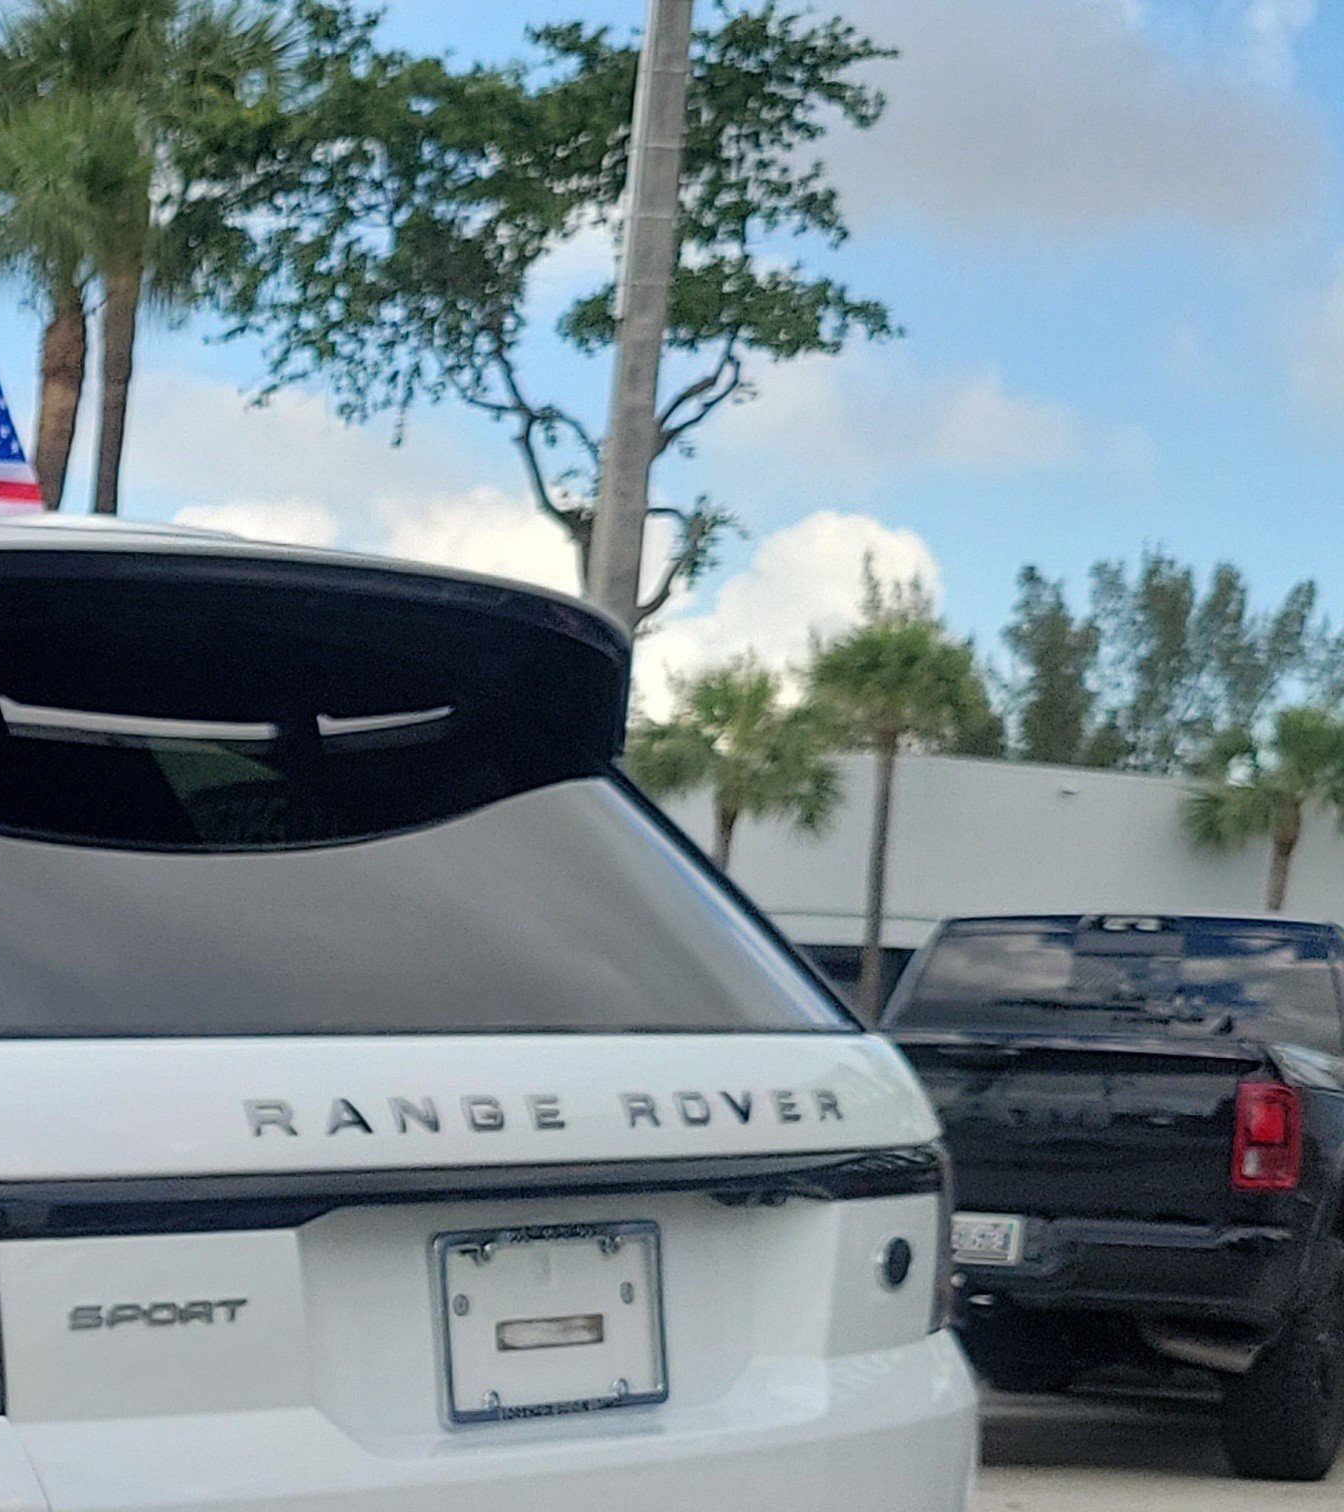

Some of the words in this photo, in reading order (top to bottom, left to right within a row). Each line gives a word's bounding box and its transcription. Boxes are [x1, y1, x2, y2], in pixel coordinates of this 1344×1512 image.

[240, 1094, 567, 1137] RANGE
[617, 1088, 844, 1128] ROVER
[68, 1297, 248, 1331] SPORT
